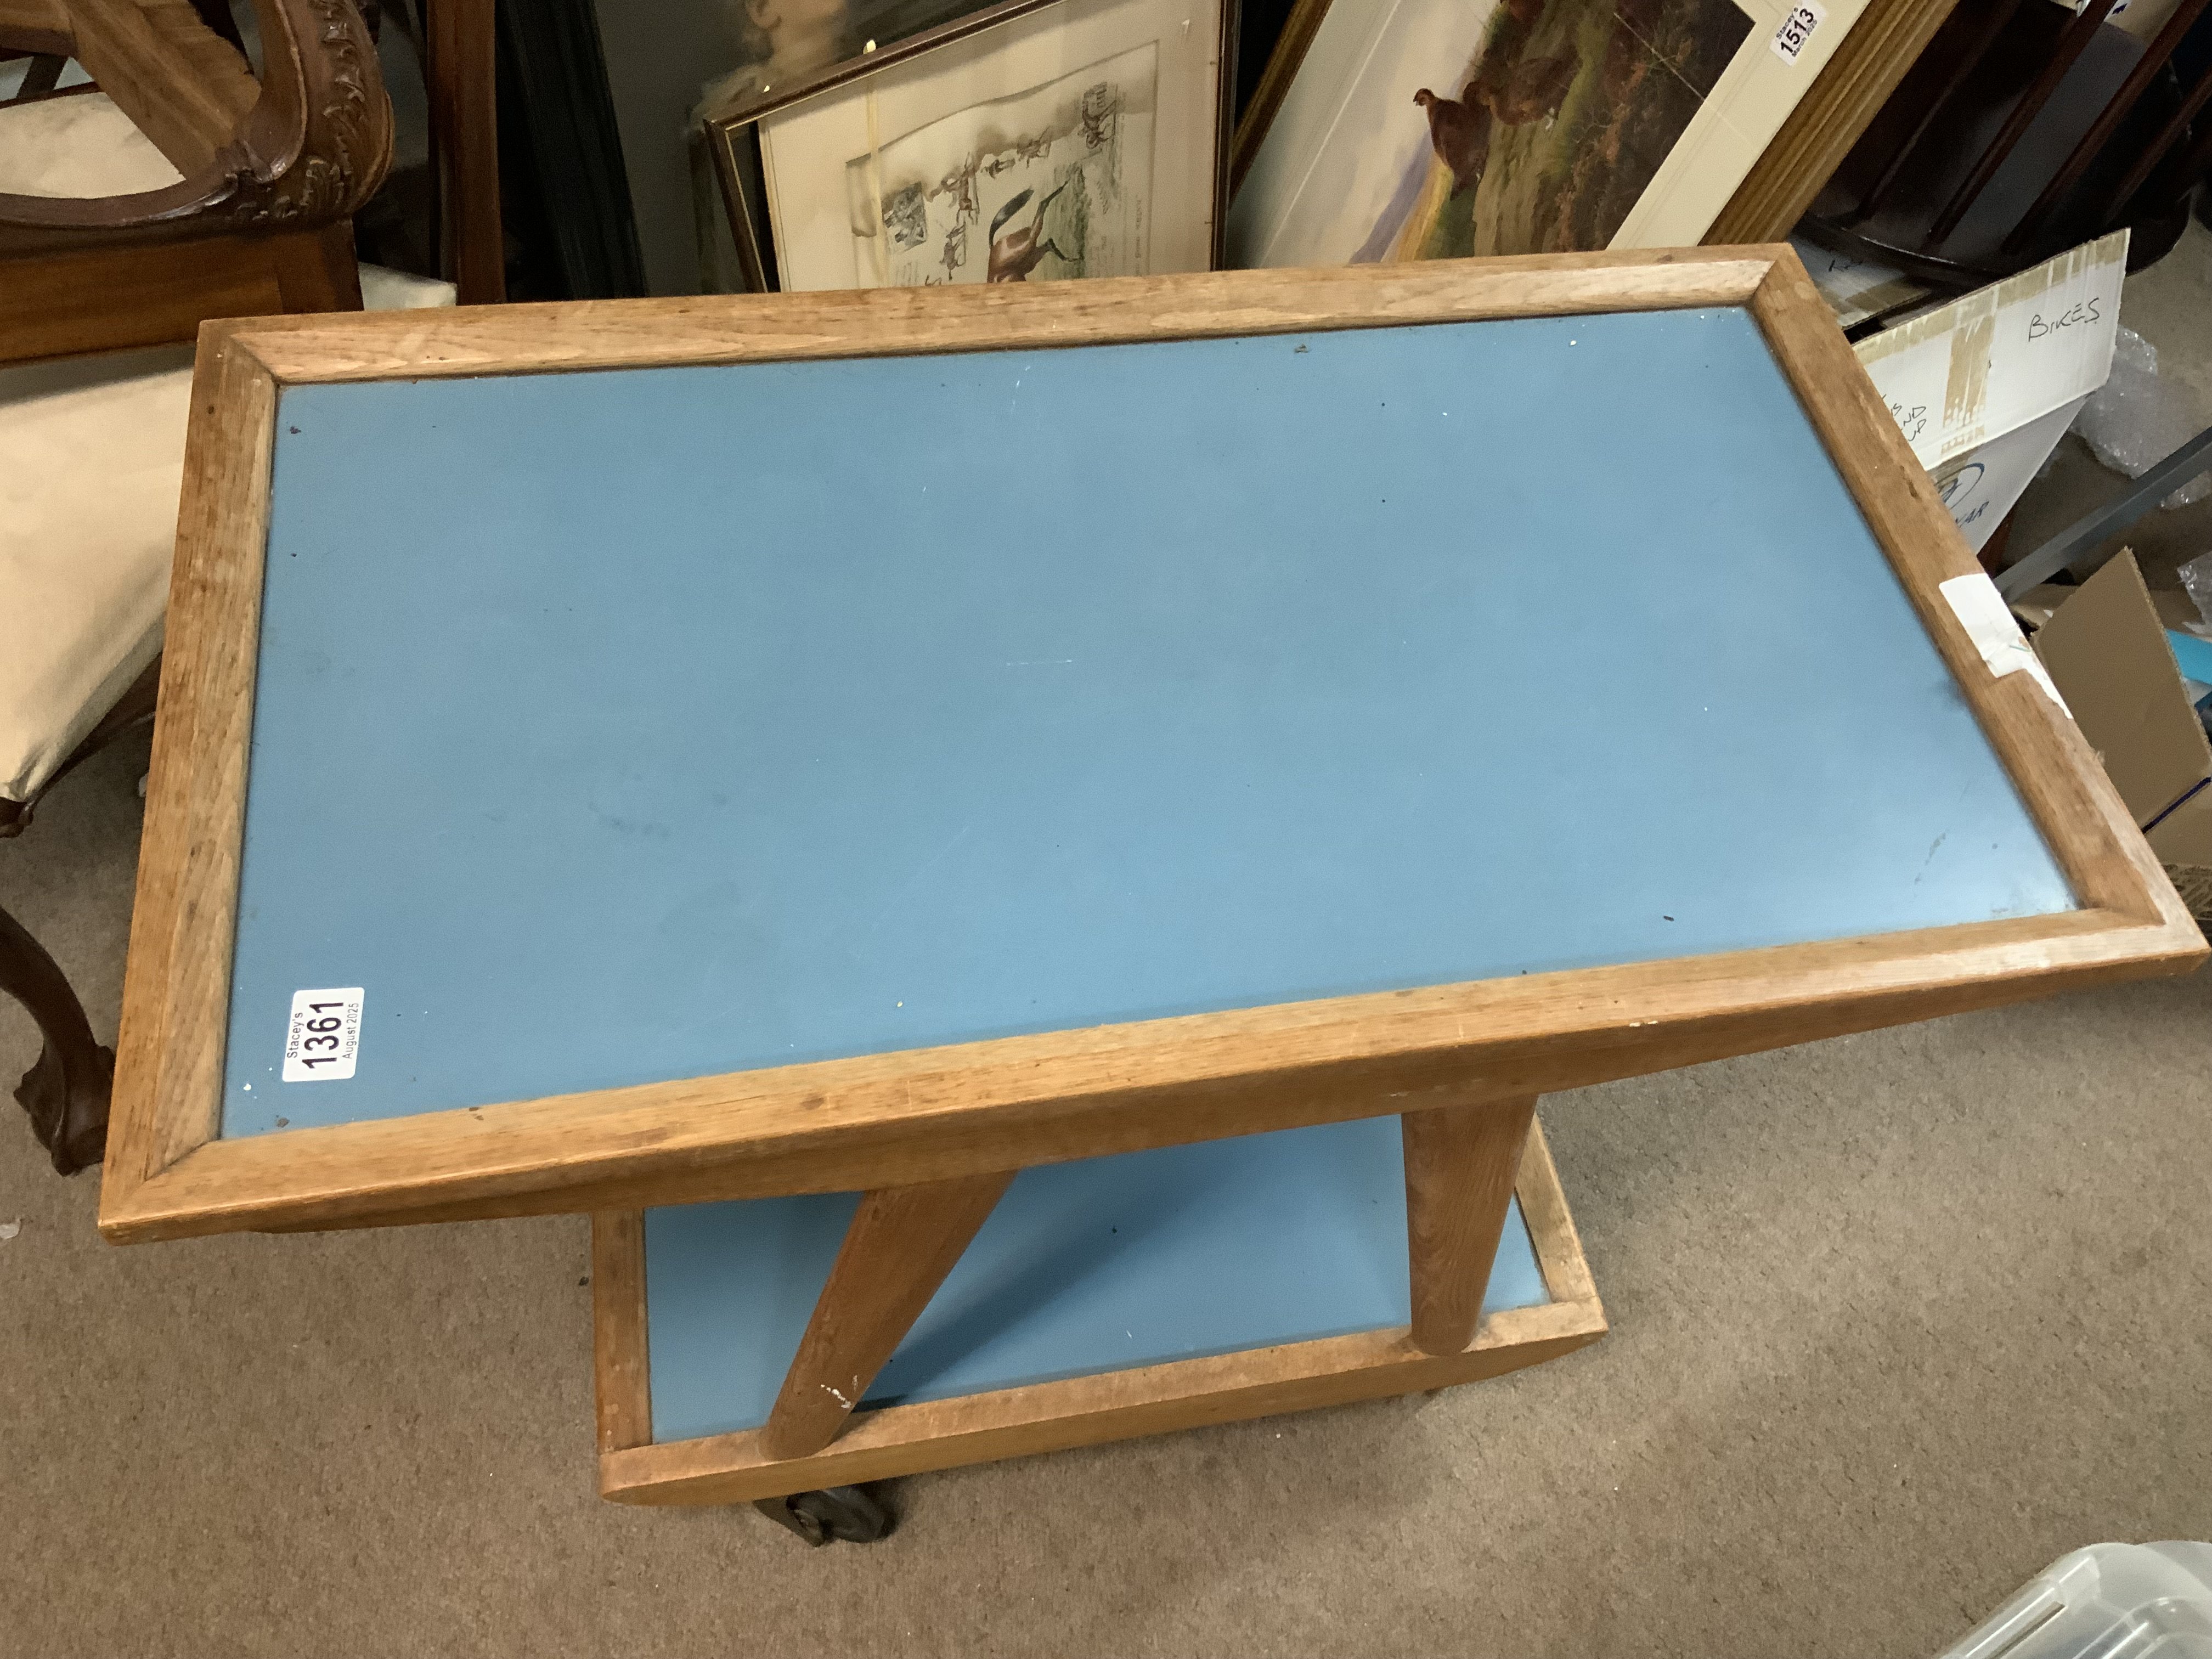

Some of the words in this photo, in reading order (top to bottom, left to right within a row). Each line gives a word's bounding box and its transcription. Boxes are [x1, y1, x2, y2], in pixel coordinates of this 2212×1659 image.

[1781, 8, 1814, 53] 1513
[1792, 37, 1807, 57] March
[2028, 297, 2100, 342] BIKES
[286, 1012, 304, 1058] Stacey's
[302, 1002, 344, 1069] 1361
[346, 1003, 359, 1024] 2025
[342, 1026, 357, 1059] August
